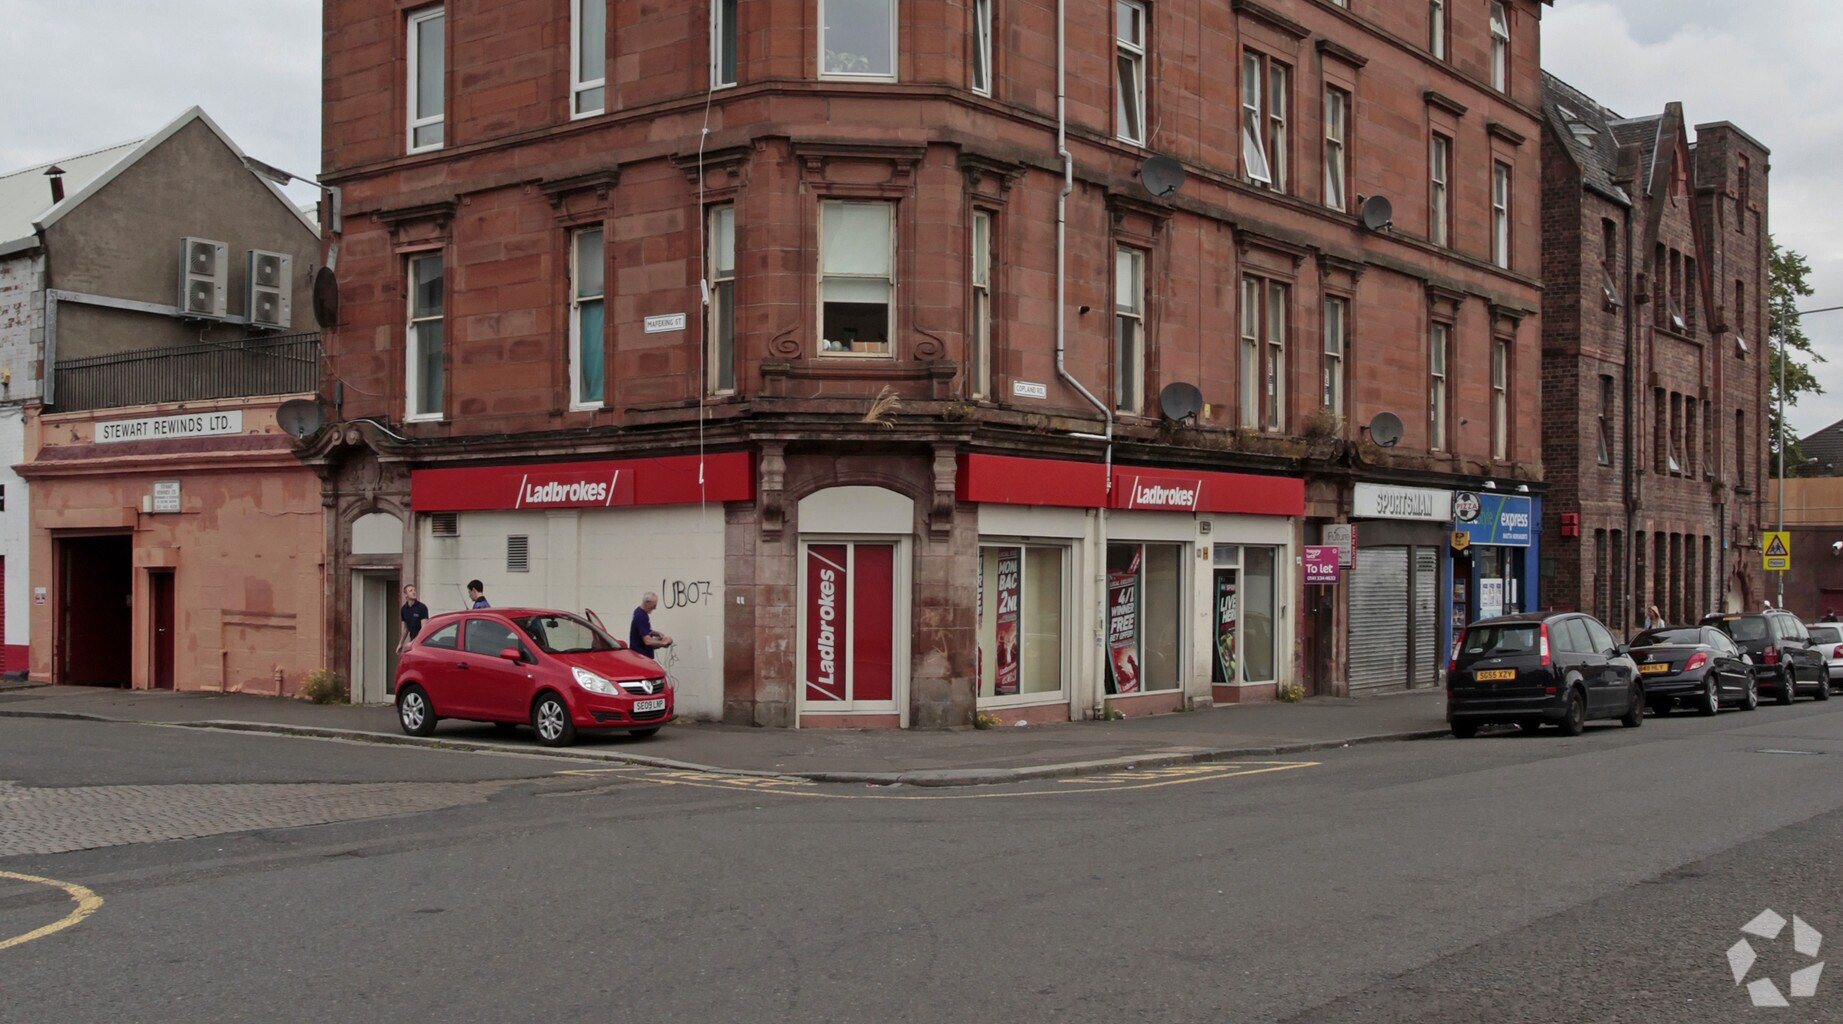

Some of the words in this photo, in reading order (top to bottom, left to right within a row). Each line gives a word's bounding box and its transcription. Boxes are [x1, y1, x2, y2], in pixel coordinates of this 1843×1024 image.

[103, 422, 148, 439] STEWART
[154, 417, 203, 435] REWINDS
[209, 416, 232, 431] LTD.
[525, 480, 607, 503] Ladbrokes
[1136, 485, 1194, 506] Ladbrokes
[1376, 489, 1432, 517] SPORTSMAN
[1456, 502, 1478, 510] PIZZA
[1500, 512, 1528, 531] express
[1306, 564, 1318, 573] To
[1319, 563, 1333, 573] let
[998, 572, 1018, 591] BAC
[817, 568, 835, 685] Ladbrokes
[1110, 614, 1135, 634] FREE
